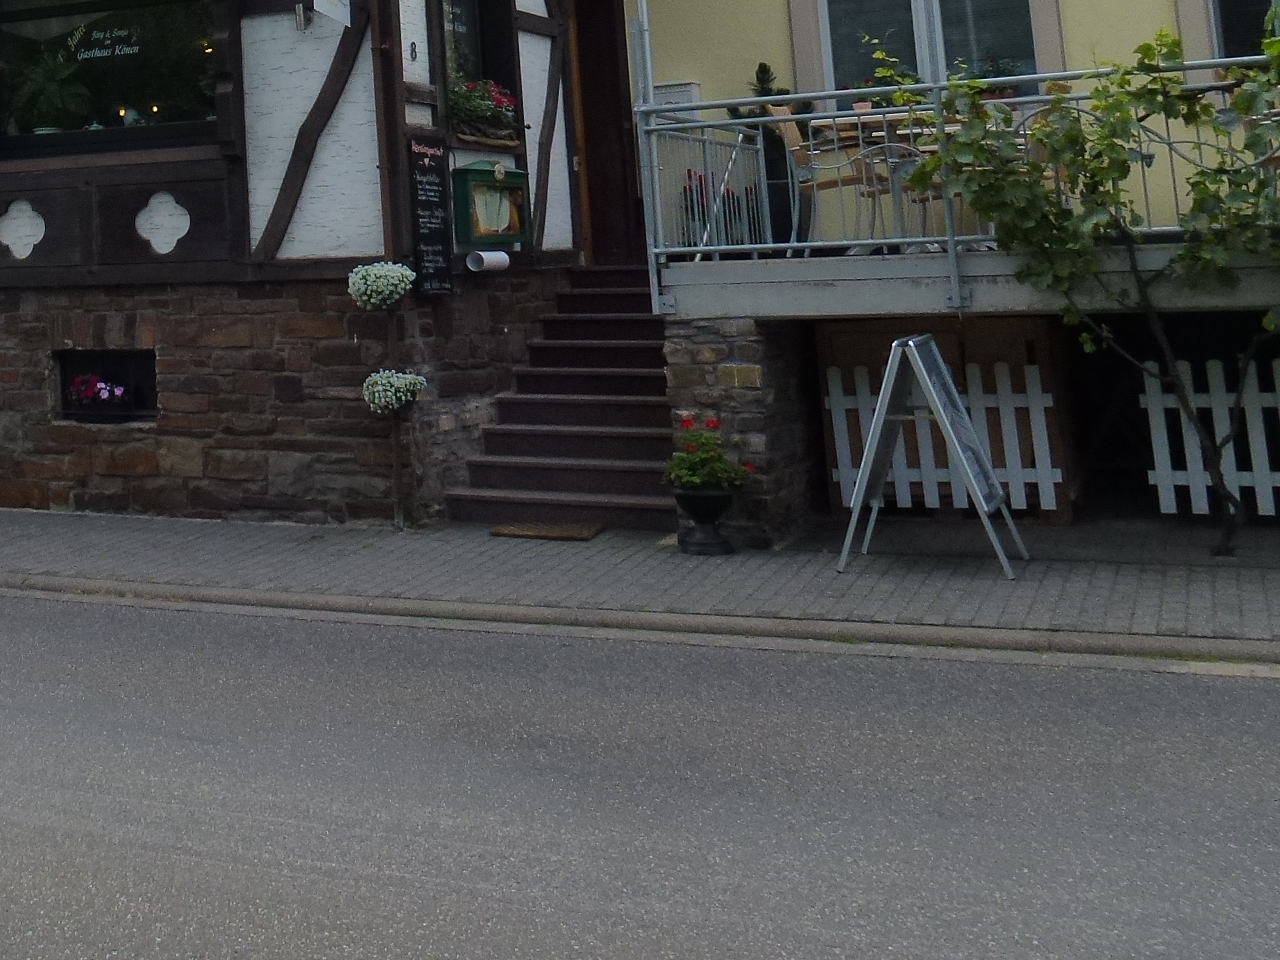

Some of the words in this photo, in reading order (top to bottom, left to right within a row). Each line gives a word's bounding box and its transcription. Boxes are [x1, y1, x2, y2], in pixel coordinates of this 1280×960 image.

[77, 46, 112, 62] Gasthaus
[114, 43, 139, 56] Könen
[410, 41, 417, 61] 8
